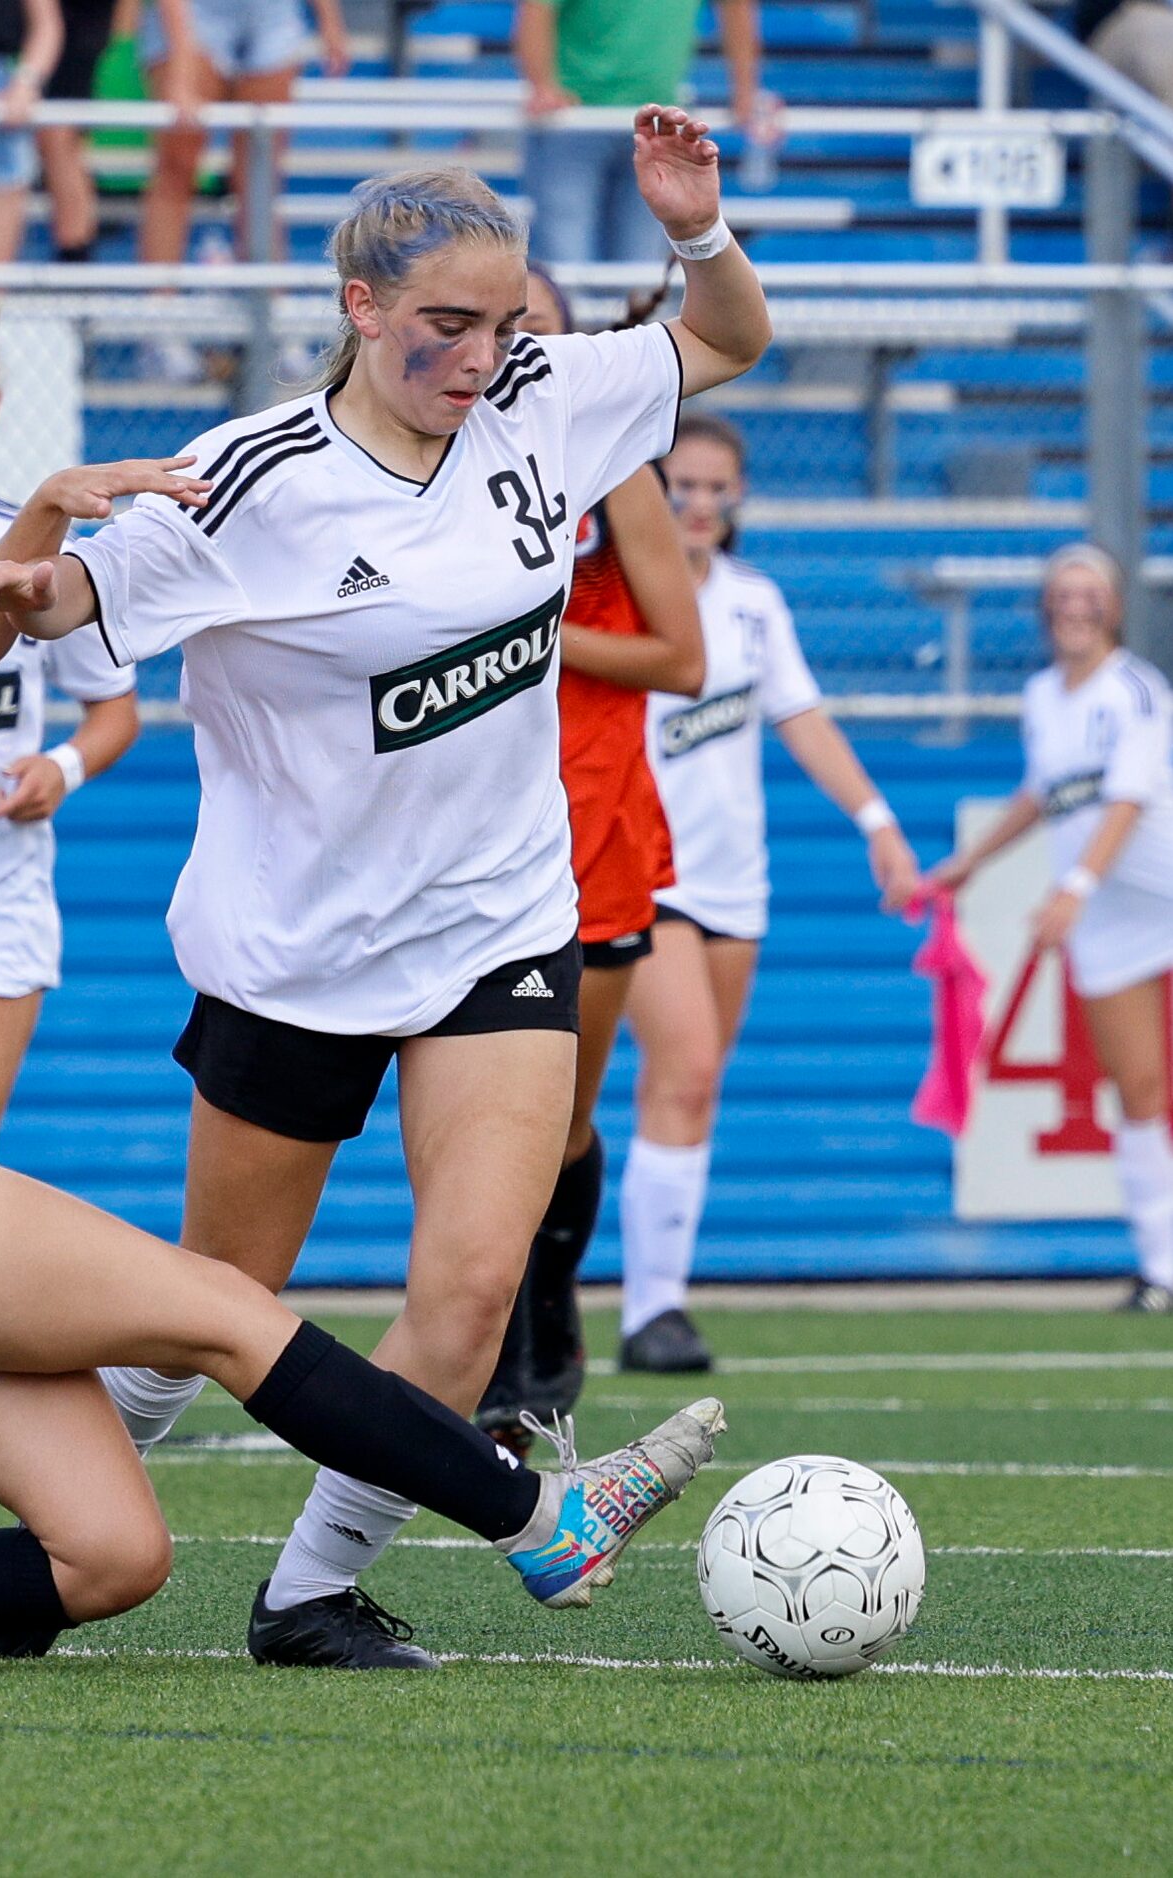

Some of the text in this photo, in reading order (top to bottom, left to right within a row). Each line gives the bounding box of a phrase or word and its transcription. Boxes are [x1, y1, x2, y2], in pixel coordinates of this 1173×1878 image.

[337, 575, 390, 598] adidas
[378, 614, 557, 732] CARROLL
[511, 986, 554, 998] adidas
[989, 930, 1173, 1153] 4
